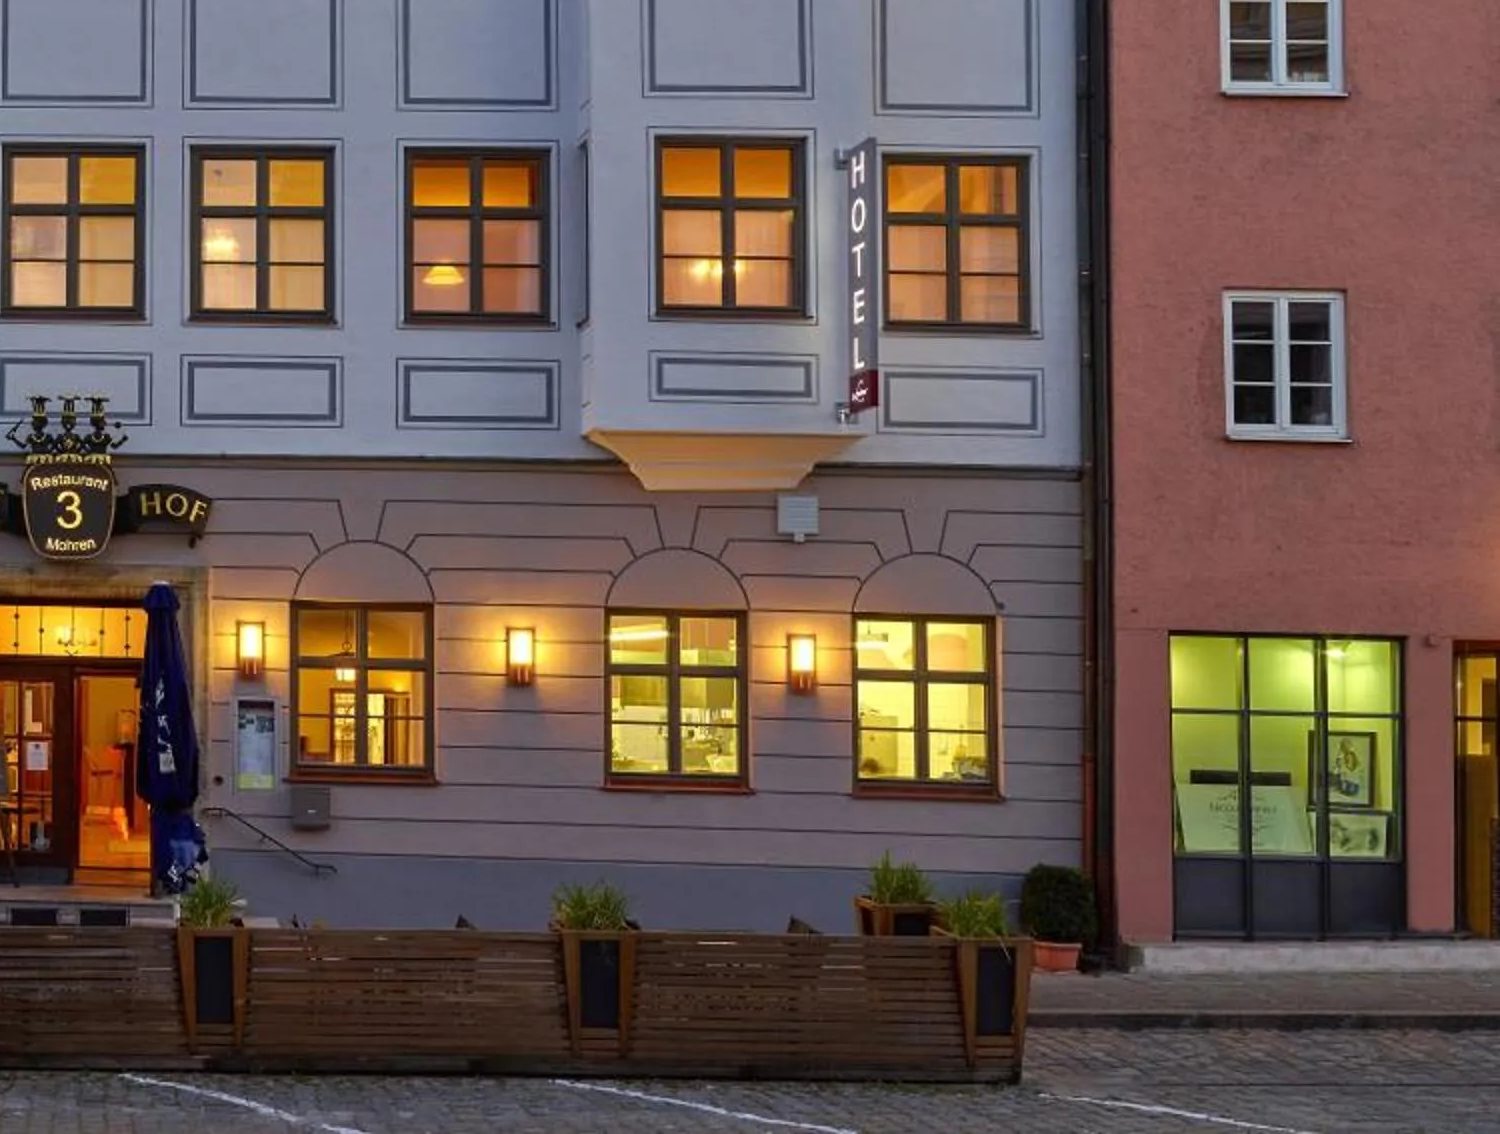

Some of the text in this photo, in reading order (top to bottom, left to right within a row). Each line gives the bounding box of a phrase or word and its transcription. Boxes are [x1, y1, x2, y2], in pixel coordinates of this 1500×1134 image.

[851, 150, 867, 371] HOTEL
[31, 473, 109, 491] Restaurant
[56, 490, 83, 529] 3
[140, 491, 208, 523] HOF
[45, 536, 97, 552] Mohren
